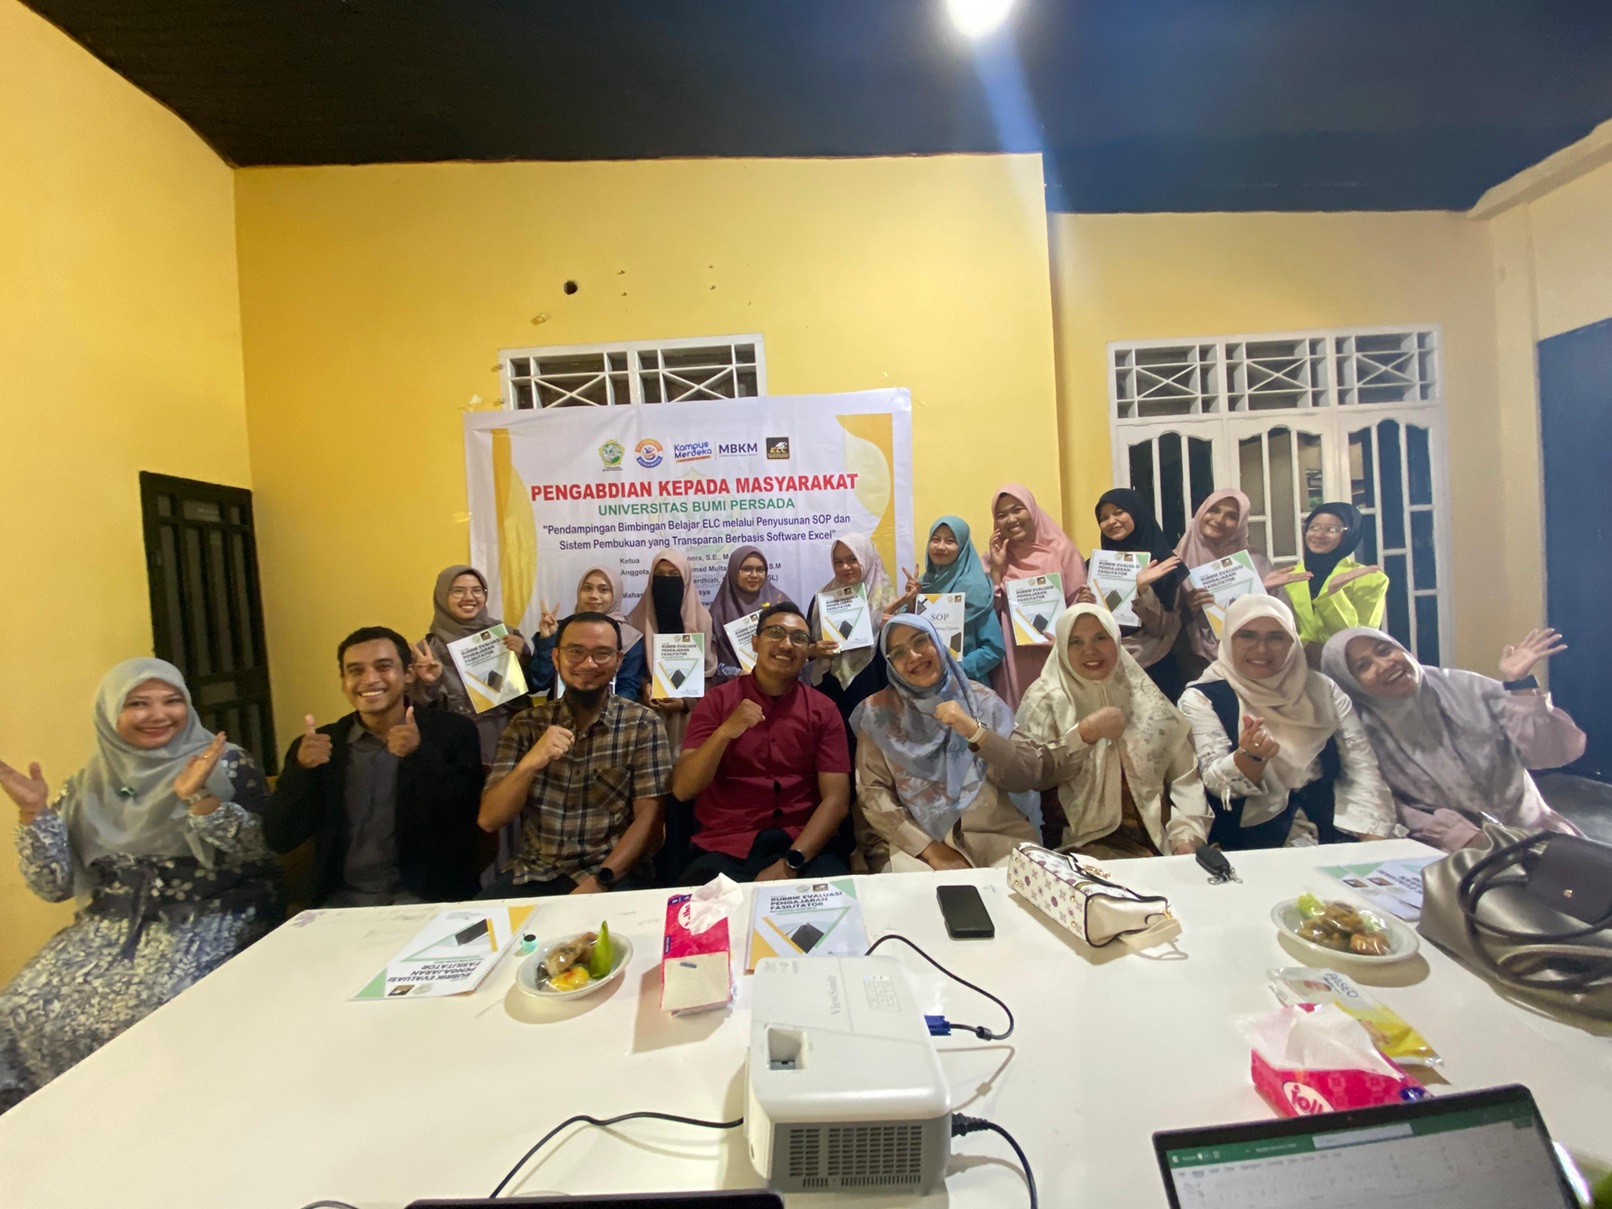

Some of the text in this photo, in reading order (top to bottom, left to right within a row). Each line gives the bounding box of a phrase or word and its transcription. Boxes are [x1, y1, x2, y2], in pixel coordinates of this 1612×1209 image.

[674, 441, 709, 452] Kampus
[719, 442, 758, 454] MBKM
[674, 448, 712, 459] Merdeka
[531, 473, 859, 501] PENGABDIAN KEPADA MASYARAKAT
[598, 498, 796, 516] UNIVERSITAS BUMI PERSADA
[543, 513, 851, 535] "Pendampingan Bimbingan Belajar ELC melalui Penyusunan SOP dan
[560, 540, 591, 551] Sistem
[593, 538, 646, 549] Pembukuan
[648, 538, 670, 549] yang
[672, 535, 723, 547] Transparan
[725, 532, 765, 544] Berbasis
[766, 530, 807, 542] Software
[686, 555, 705, 563] nora,
[620, 568, 650, 577] Anggota
[691, 565, 709, 573] mad
[708, 564, 728, 573] Multa
[693, 576, 721, 585] ardhiah,
[930, 613, 950, 621] SOP
[802, 891, 843, 900] EVALUASI
[770, 897, 828, 906] PENGAJARAN
[770, 902, 824, 910] FASILITATOR
[421, 960, 482, 970] FASILITATOR
[386, 972, 472, 982] RUBRIK EVALUASI
[410, 967, 477, 976] PENGAJARAN
[1325, 972, 1359, 998] PASEO
[1290, 1084, 1323, 1115] joll
